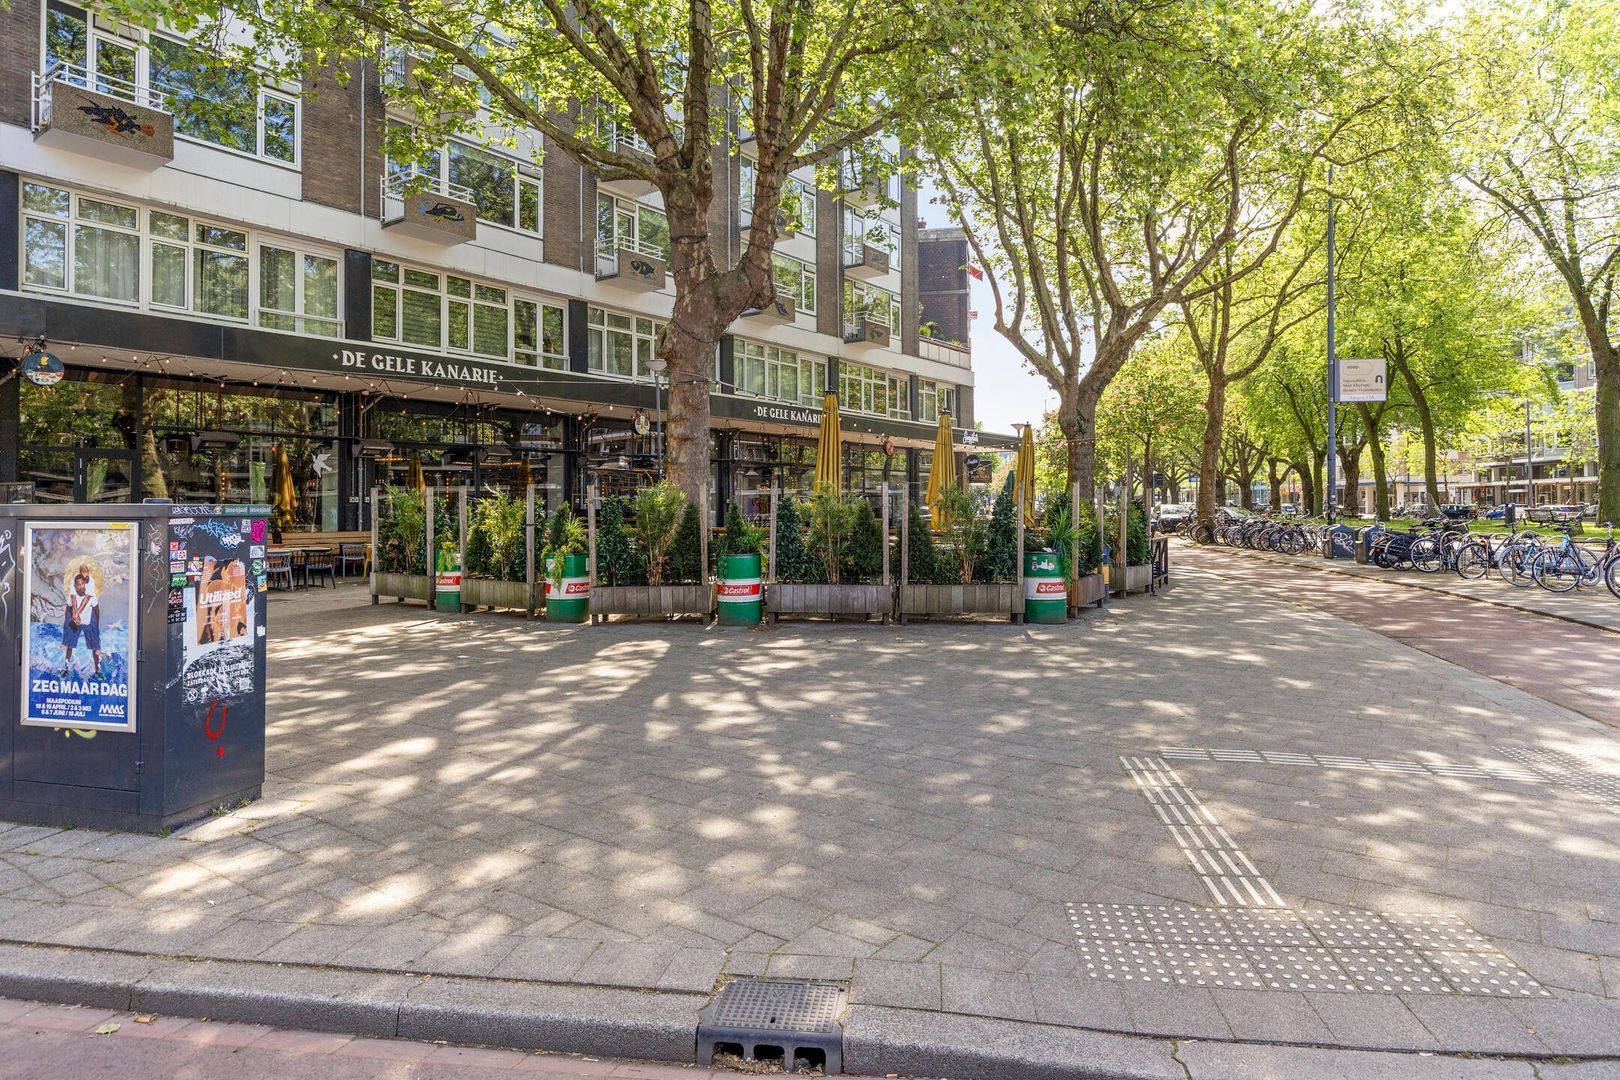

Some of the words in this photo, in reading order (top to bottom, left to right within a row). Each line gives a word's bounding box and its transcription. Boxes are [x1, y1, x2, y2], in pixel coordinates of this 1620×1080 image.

[342, 350, 366, 368] DE
[372, 354, 416, 374] GELE
[420, 360, 498, 384] KANARIE
[758, 406, 768, 417] DE
[770, 408, 788, 419] GELE
[790, 410, 822, 424] KANARI
[200, 587, 242, 605] Utilized
[32, 680, 59, 693] ZEG
[60, 681, 99, 696] MAAR
[100, 683, 128, 696] DAG
[99, 704, 124, 714] MAAS
